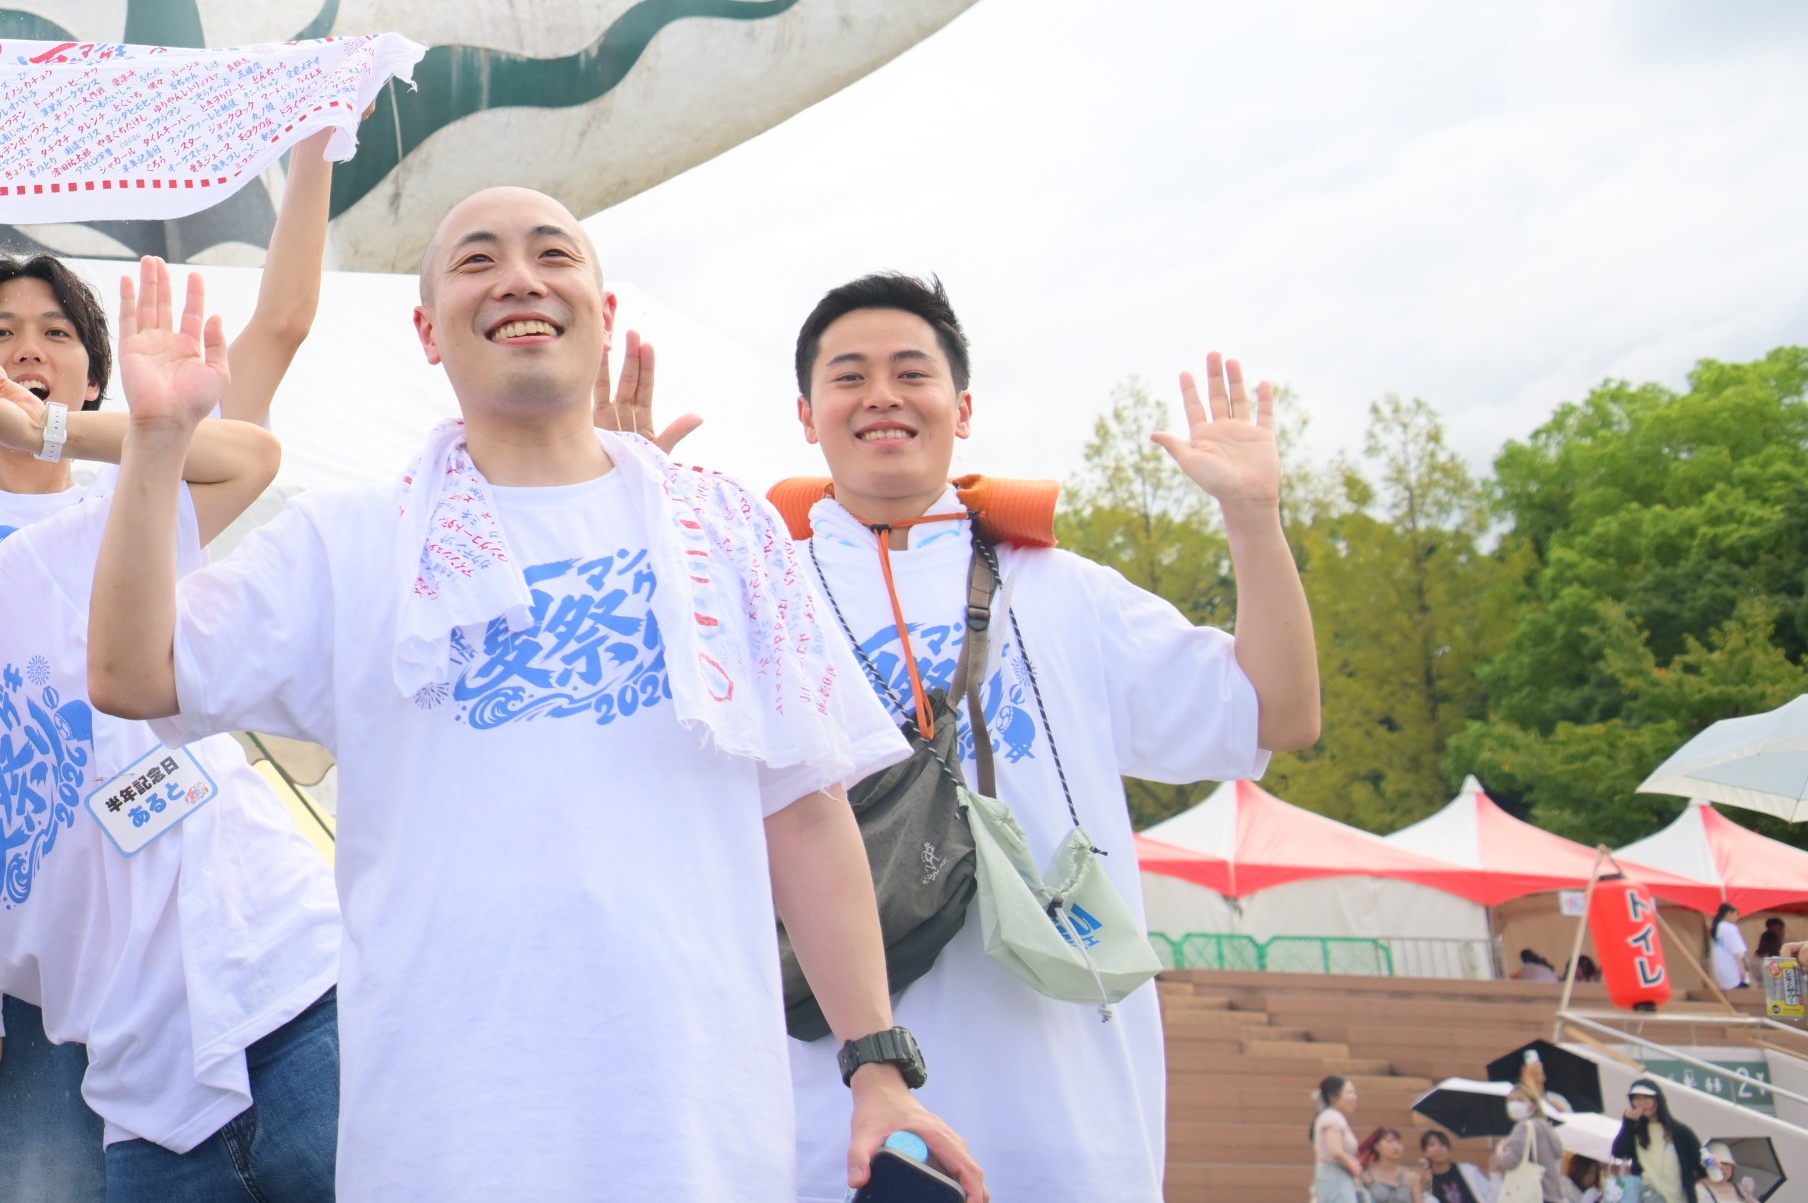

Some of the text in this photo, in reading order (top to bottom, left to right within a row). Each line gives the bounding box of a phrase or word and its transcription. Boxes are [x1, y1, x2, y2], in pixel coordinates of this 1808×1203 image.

[54, 746, 87, 829] 2026
[104, 755, 180, 813] 半年記念日
[127, 782, 186, 828] あると
[1625, 889, 1665, 988] トイレ
